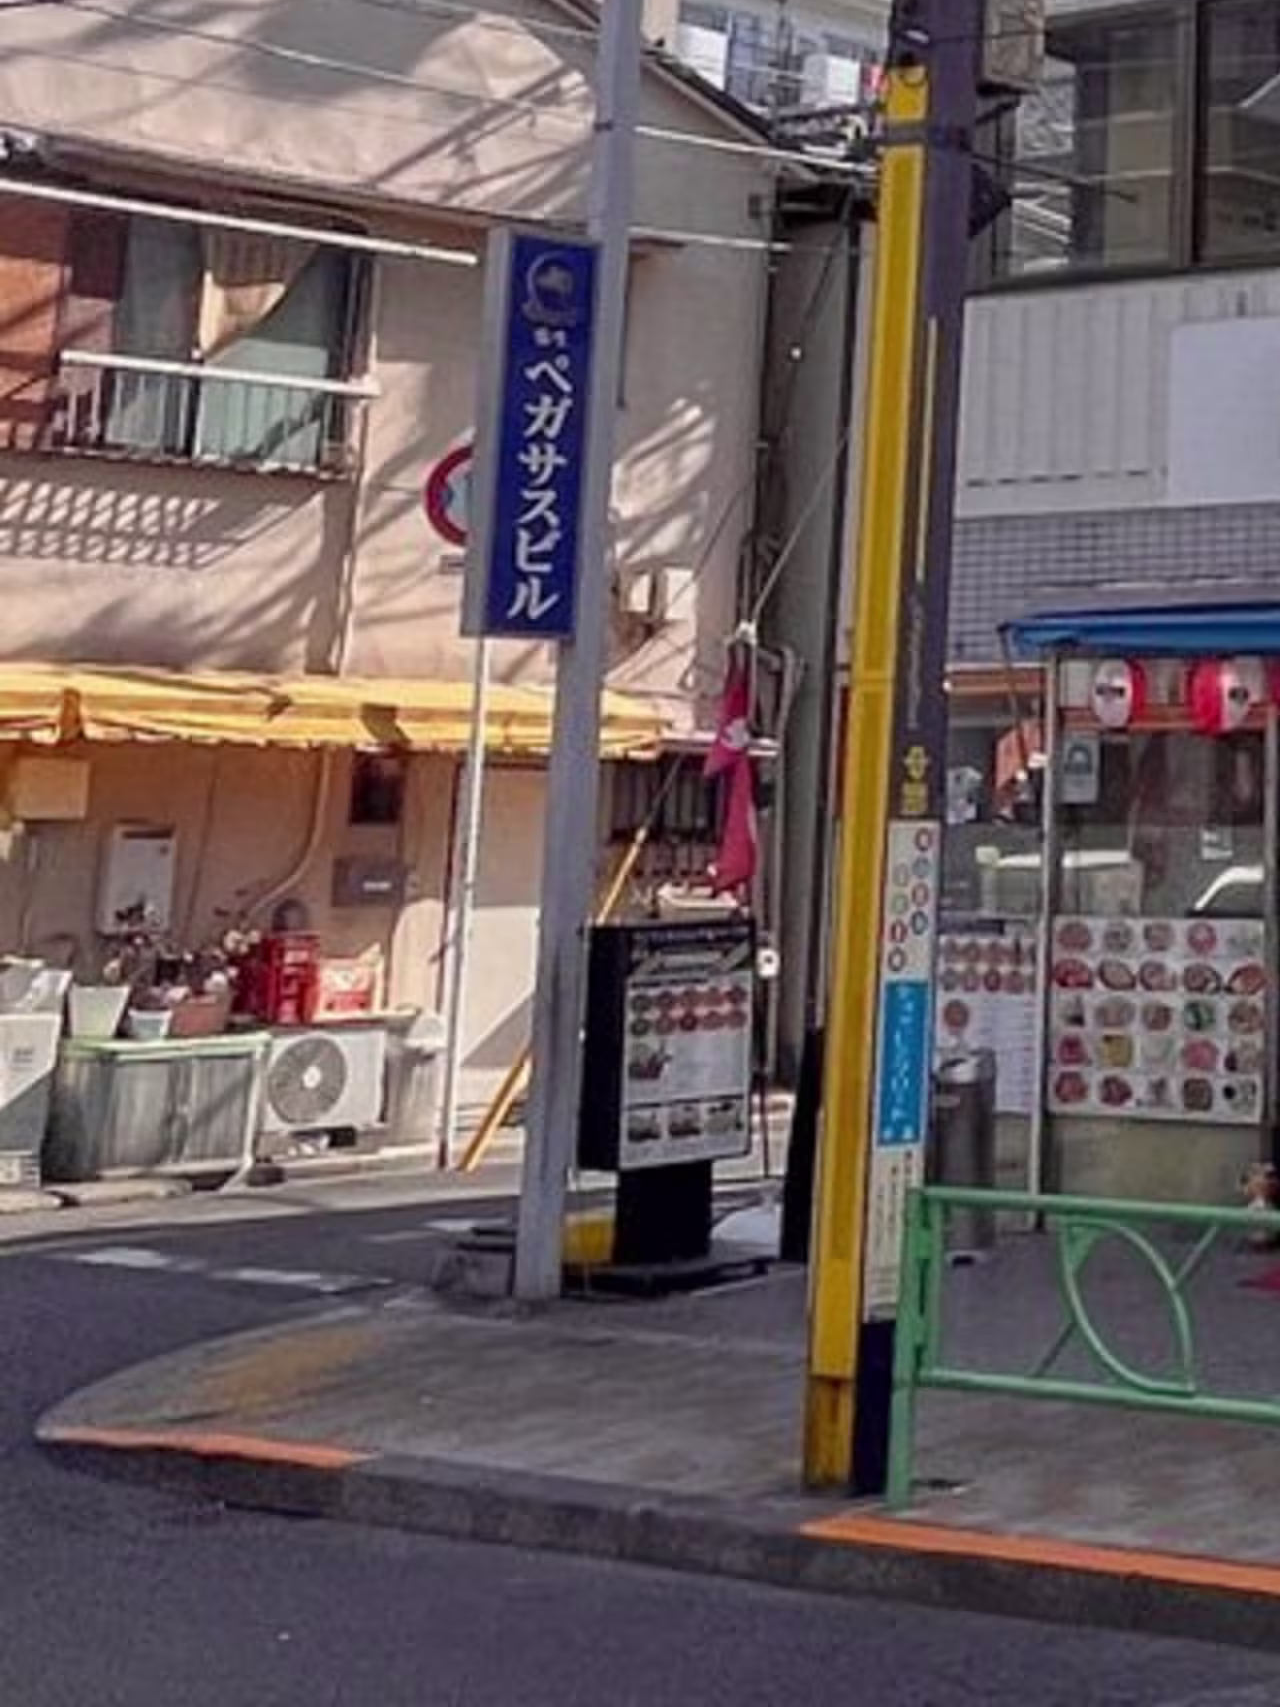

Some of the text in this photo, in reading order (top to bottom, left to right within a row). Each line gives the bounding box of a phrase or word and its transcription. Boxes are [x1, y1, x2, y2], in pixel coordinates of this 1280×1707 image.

[508, 356, 573, 620] ペガサスビル
